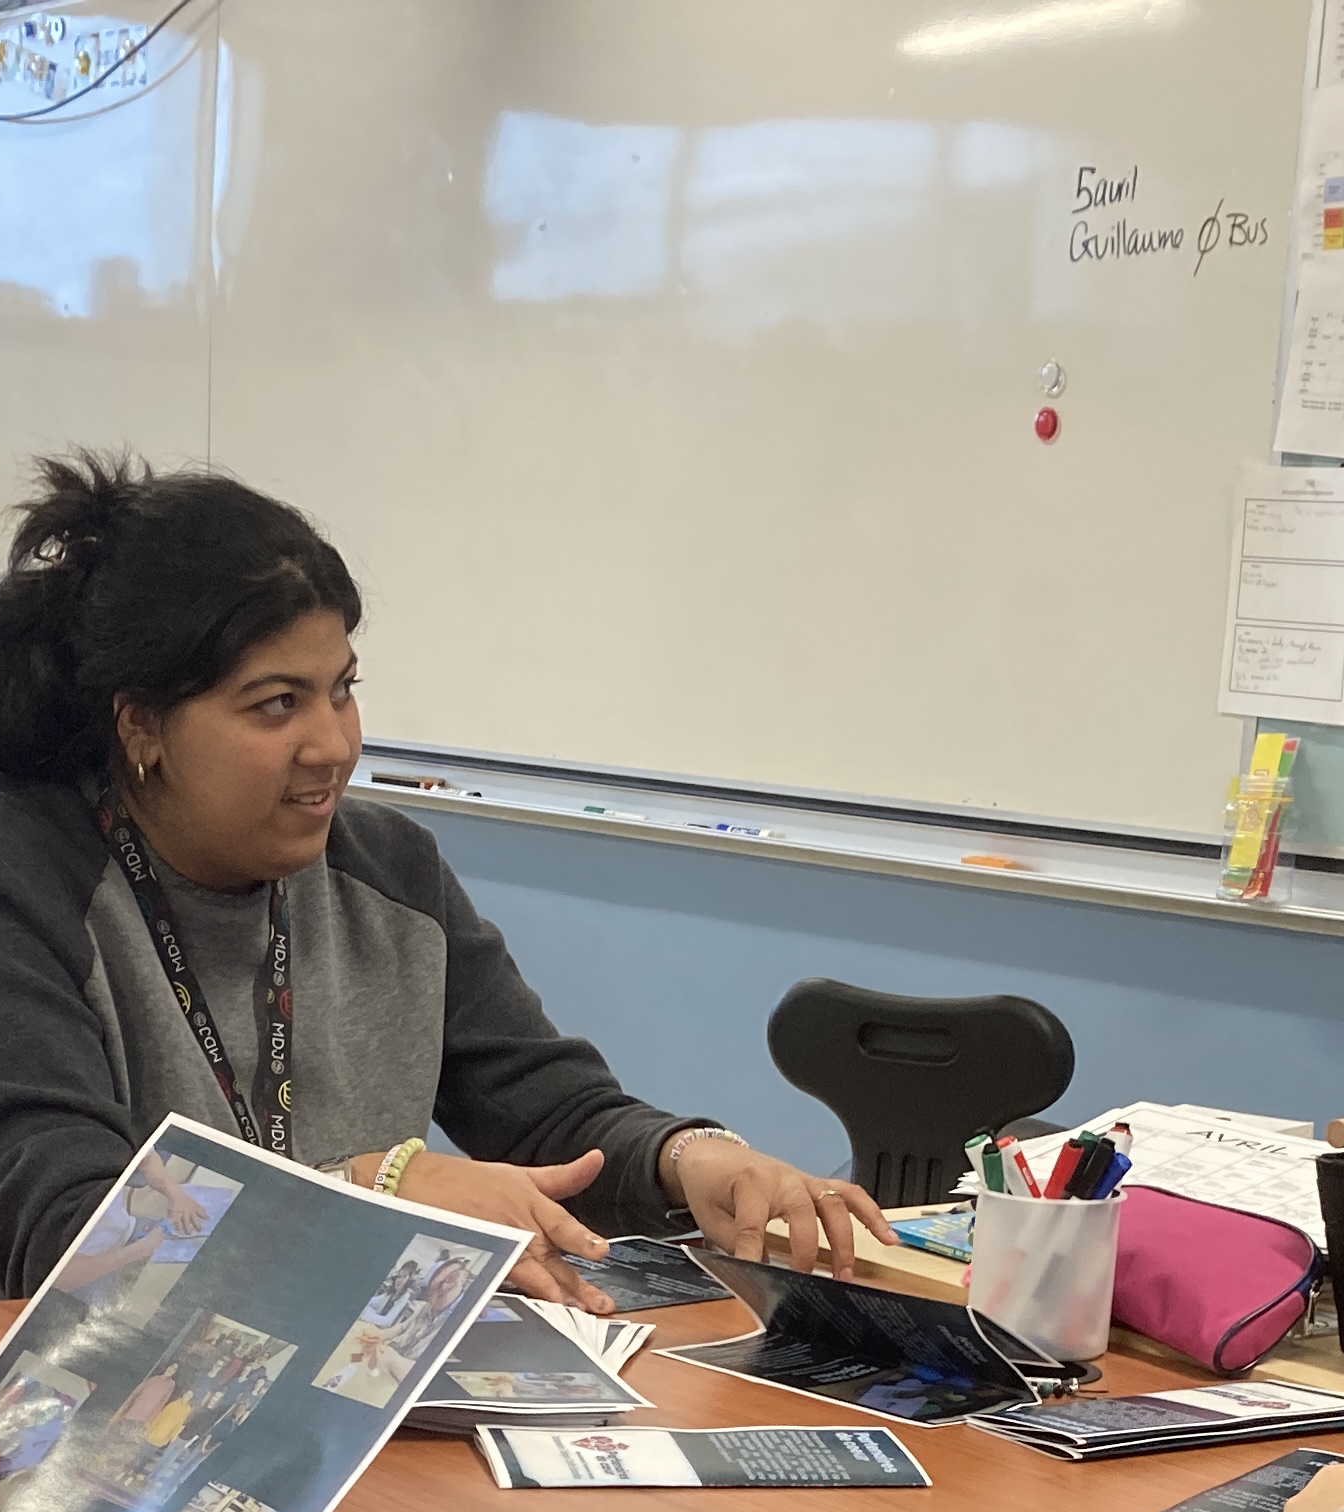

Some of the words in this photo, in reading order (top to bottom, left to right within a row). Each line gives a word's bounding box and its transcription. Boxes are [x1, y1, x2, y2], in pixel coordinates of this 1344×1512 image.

[1069, 219, 1184, 262] Guillaume
[1226, 213, 1268, 246] Bus
[120, 842, 147, 883] MDJ
[162, 934, 186, 973] MDJ
[272, 933, 287, 975] MDJ
[198, 1026, 223, 1064] MDJ
[271, 1022, 285, 1061] MDJ
[271, 1114, 286, 1152] MDJ
[1185, 1131, 1288, 1156] AVRIL
